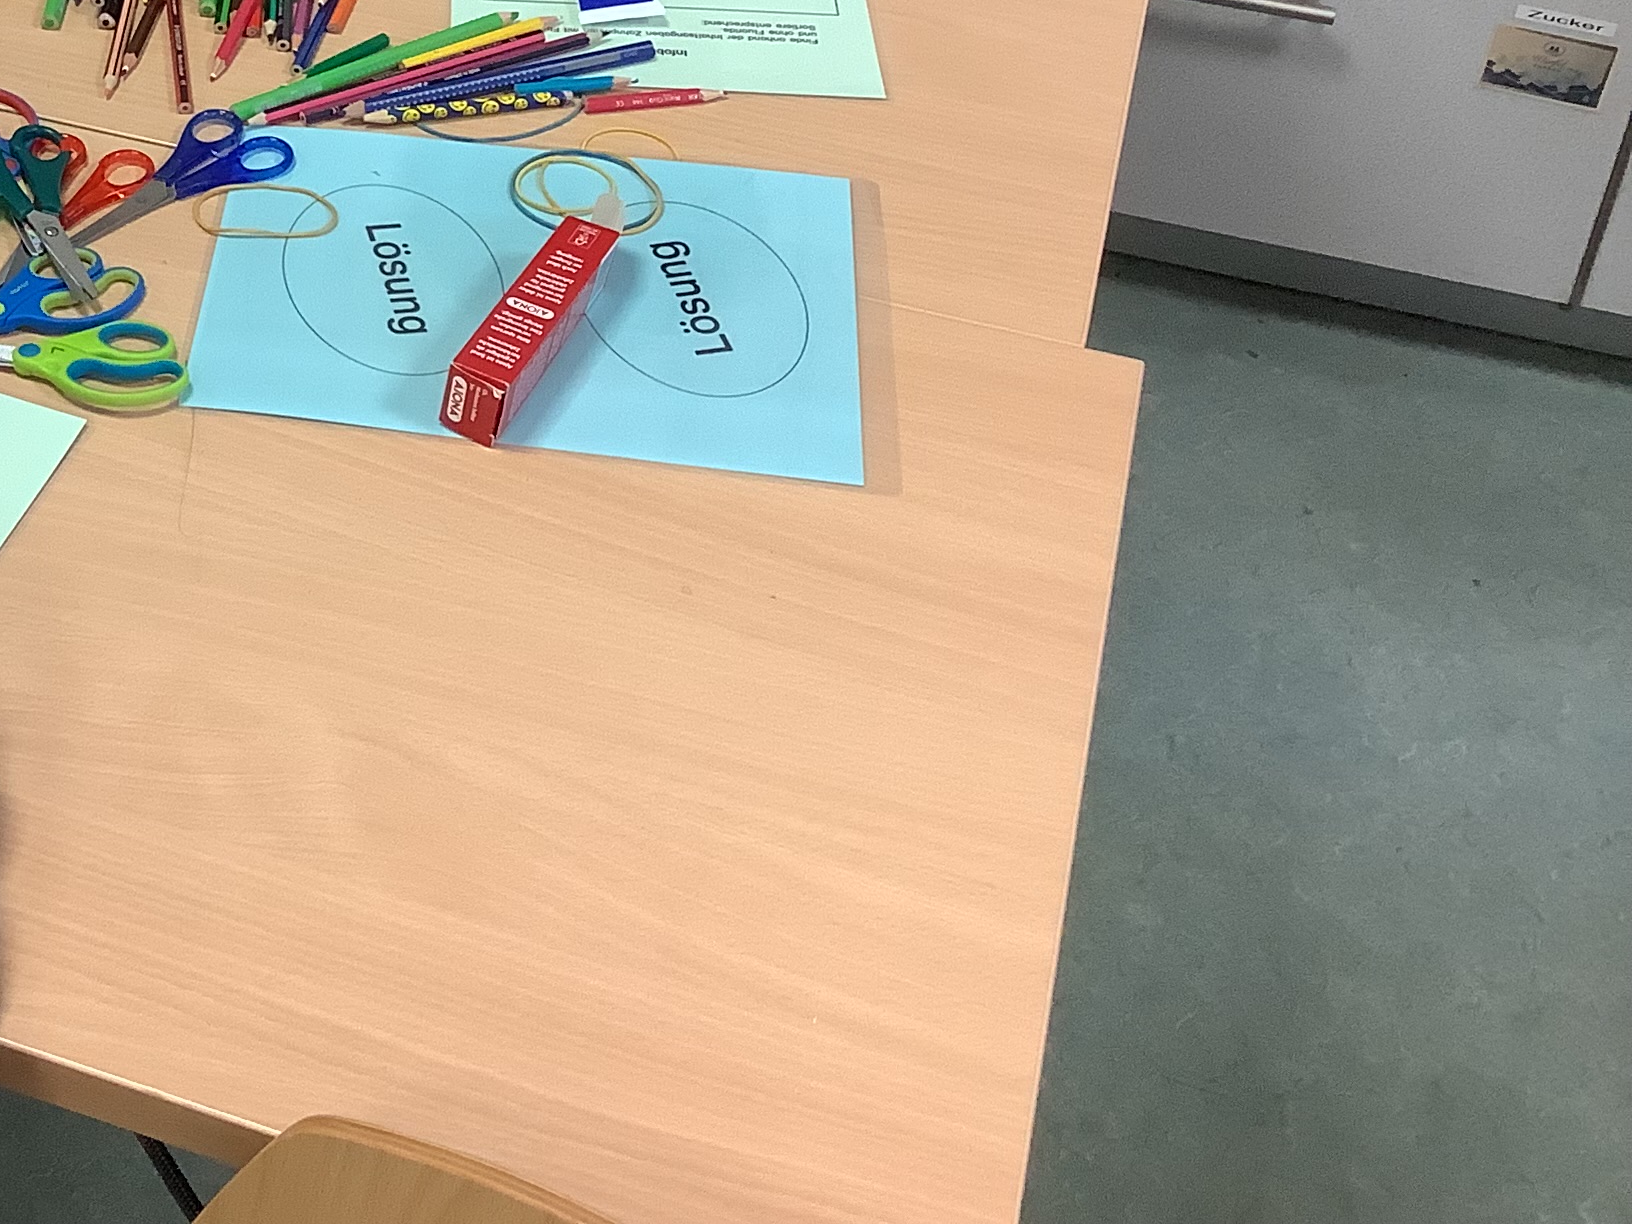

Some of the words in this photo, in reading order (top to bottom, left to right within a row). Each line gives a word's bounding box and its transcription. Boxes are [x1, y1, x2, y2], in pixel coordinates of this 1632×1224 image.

[656, 47, 688, 57] Infob
[1528, 9, 1605, 32] Zucker
[365, 222, 428, 335] Lösung
[650, 240, 733, 358] Lösung
